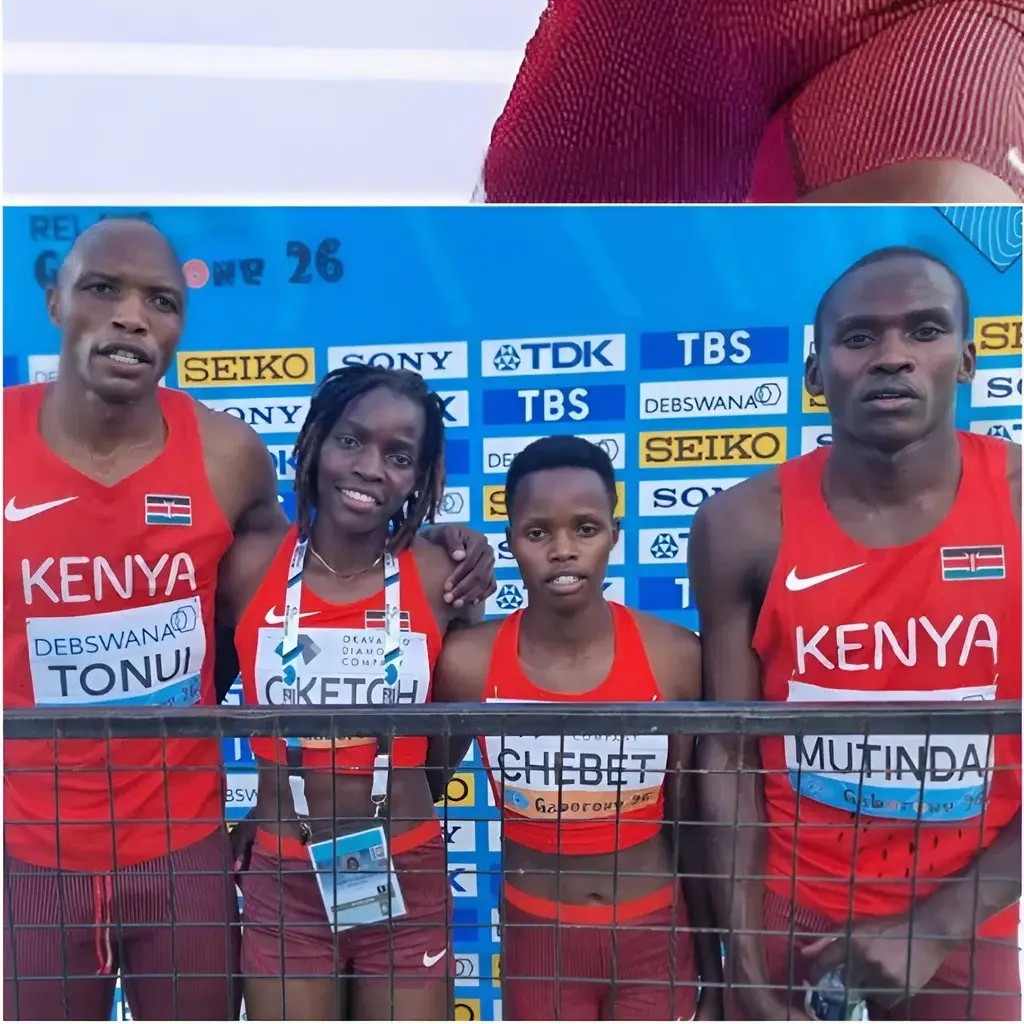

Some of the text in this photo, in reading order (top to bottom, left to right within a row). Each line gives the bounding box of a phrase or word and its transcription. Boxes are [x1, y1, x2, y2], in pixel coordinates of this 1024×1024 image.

[286, 237, 344, 284] 26
[521, 339, 614, 370] TDK
[677, 330, 751, 366] TBS
[184, 353, 309, 383] SEIKO
[518, 388, 590, 422] TBS
[645, 394, 758, 414] DEBSWANA
[645, 432, 780, 463] SEIKO
[21, 552, 197, 605] KENYA
[35, 624, 176, 657] DEBSWANA
[796, 614, 998, 674] KENYA
[48, 647, 191, 697] TONUI
[498, 748, 656, 786] CHEBET
[795, 735, 984, 782] MUTINDA
